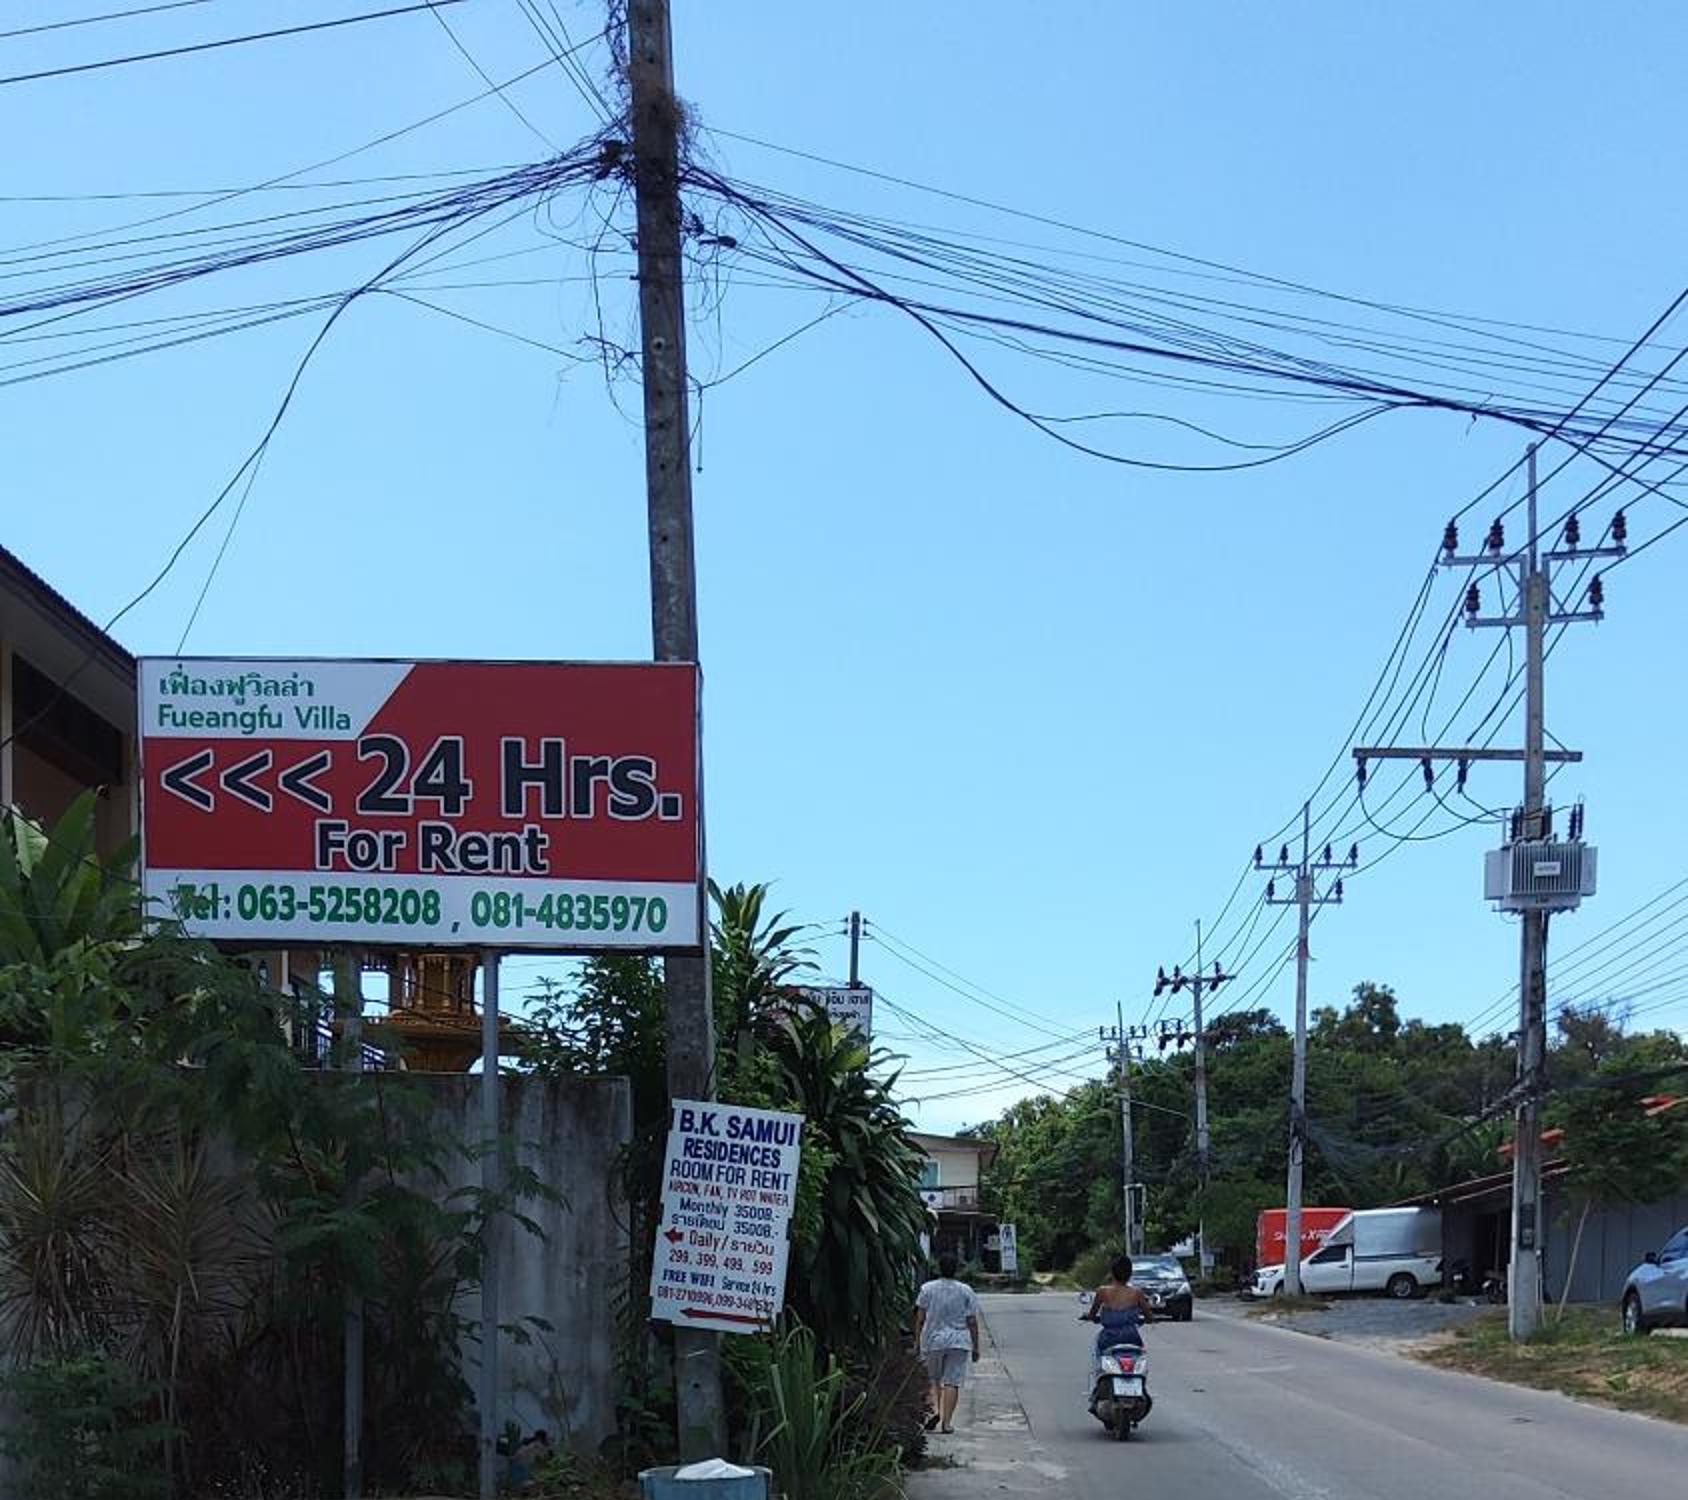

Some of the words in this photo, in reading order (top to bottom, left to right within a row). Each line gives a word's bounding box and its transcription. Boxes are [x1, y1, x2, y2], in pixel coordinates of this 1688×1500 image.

[159, 663, 315, 705] เฟื่องฟูวิลล่า
[158, 704, 283, 735] Fueangfu
[294, 705, 351, 731] Villa
[356, 735, 473, 817] 24
[500, 736, 683, 821] Hrs.
[315, 818, 406, 872] For
[418, 820, 550, 874] Rent
[237, 884, 441, 926] 063-5258208
[471, 890, 668, 933] 081-4835970
[726, 1115, 795, 1146] SAMUI
[683, 1137, 781, 1169] RESIDENCES
[671, 1159, 713, 1181] ROOM
[716, 1165, 746, 1186] FOR
[750, 1169, 793, 1191] RENT
[680, 1198, 728, 1218] Monthly
[663, 1269, 687, 1283] FREE
[752, 1261, 773, 1275] 599
